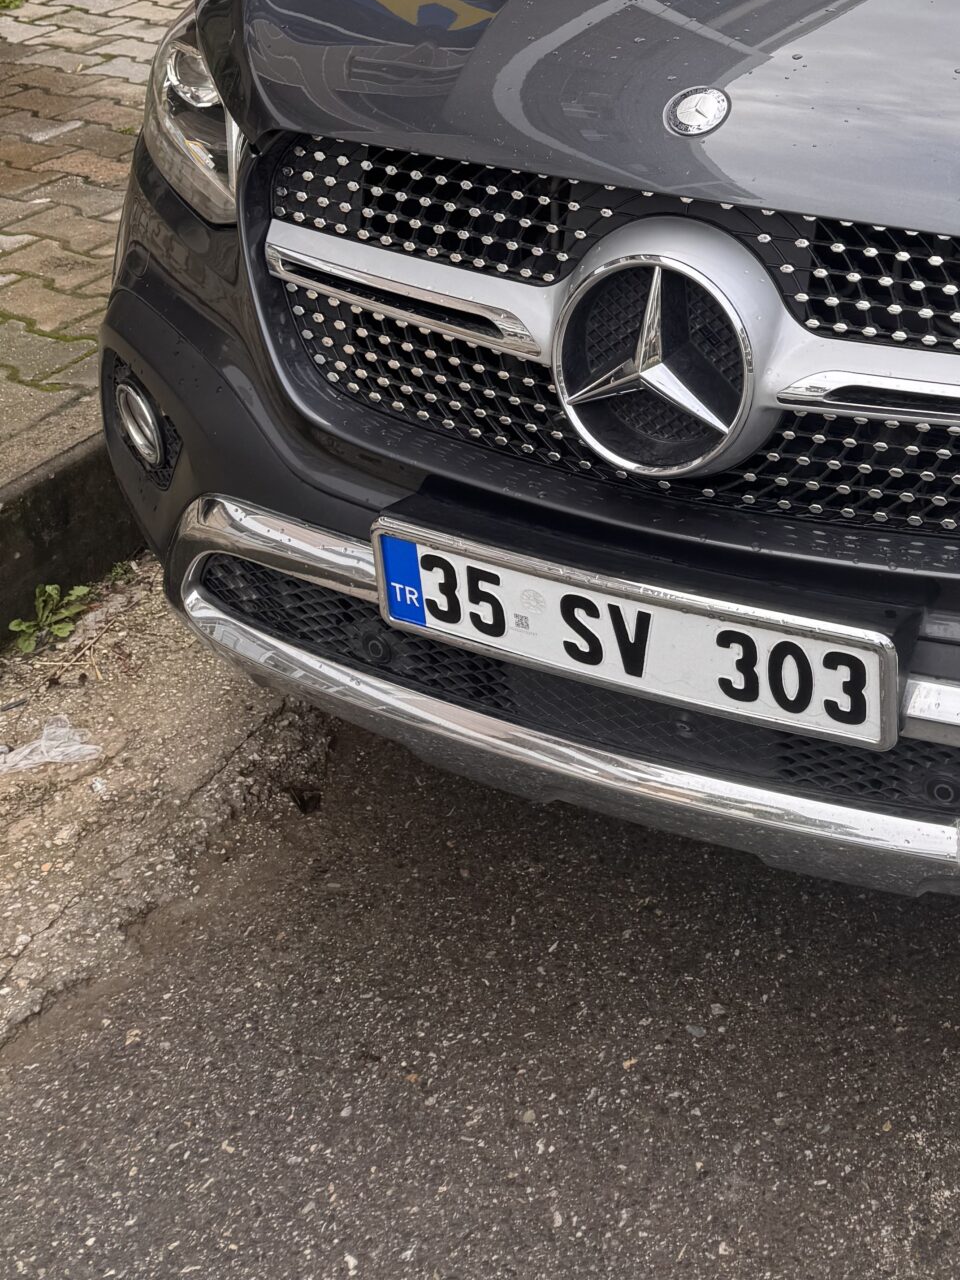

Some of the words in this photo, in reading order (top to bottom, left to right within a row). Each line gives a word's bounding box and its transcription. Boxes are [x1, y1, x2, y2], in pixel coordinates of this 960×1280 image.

[390, 581, 420, 608] TR
[420, 554, 506, 638] 35
[559, 593, 652, 678] SV
[716, 629, 868, 726] 303
